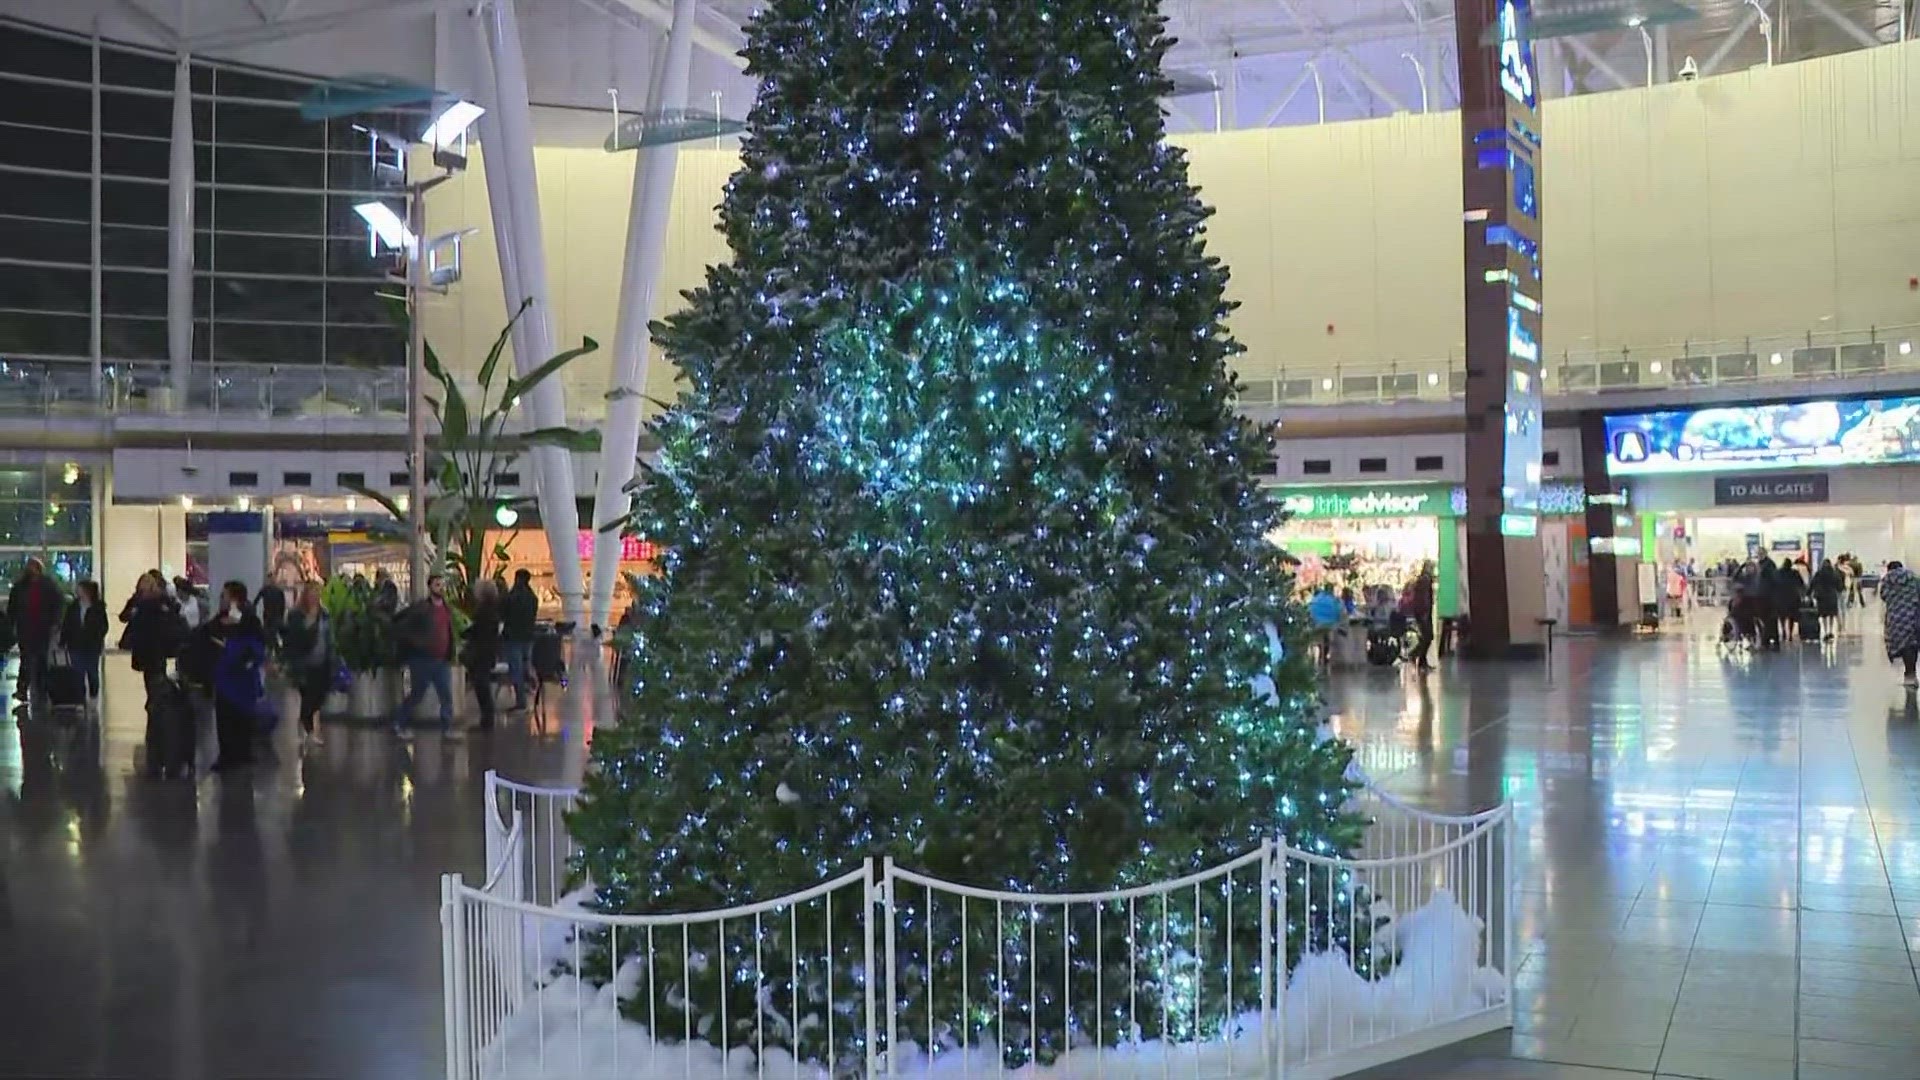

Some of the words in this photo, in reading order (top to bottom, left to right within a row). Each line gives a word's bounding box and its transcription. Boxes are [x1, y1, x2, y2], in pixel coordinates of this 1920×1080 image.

[1730, 485, 1746, 496] TO
[1750, 484, 1770, 495] ALL
[1774, 483, 1814, 495] GATES
[1317, 491, 1427, 516] tripadvisor
